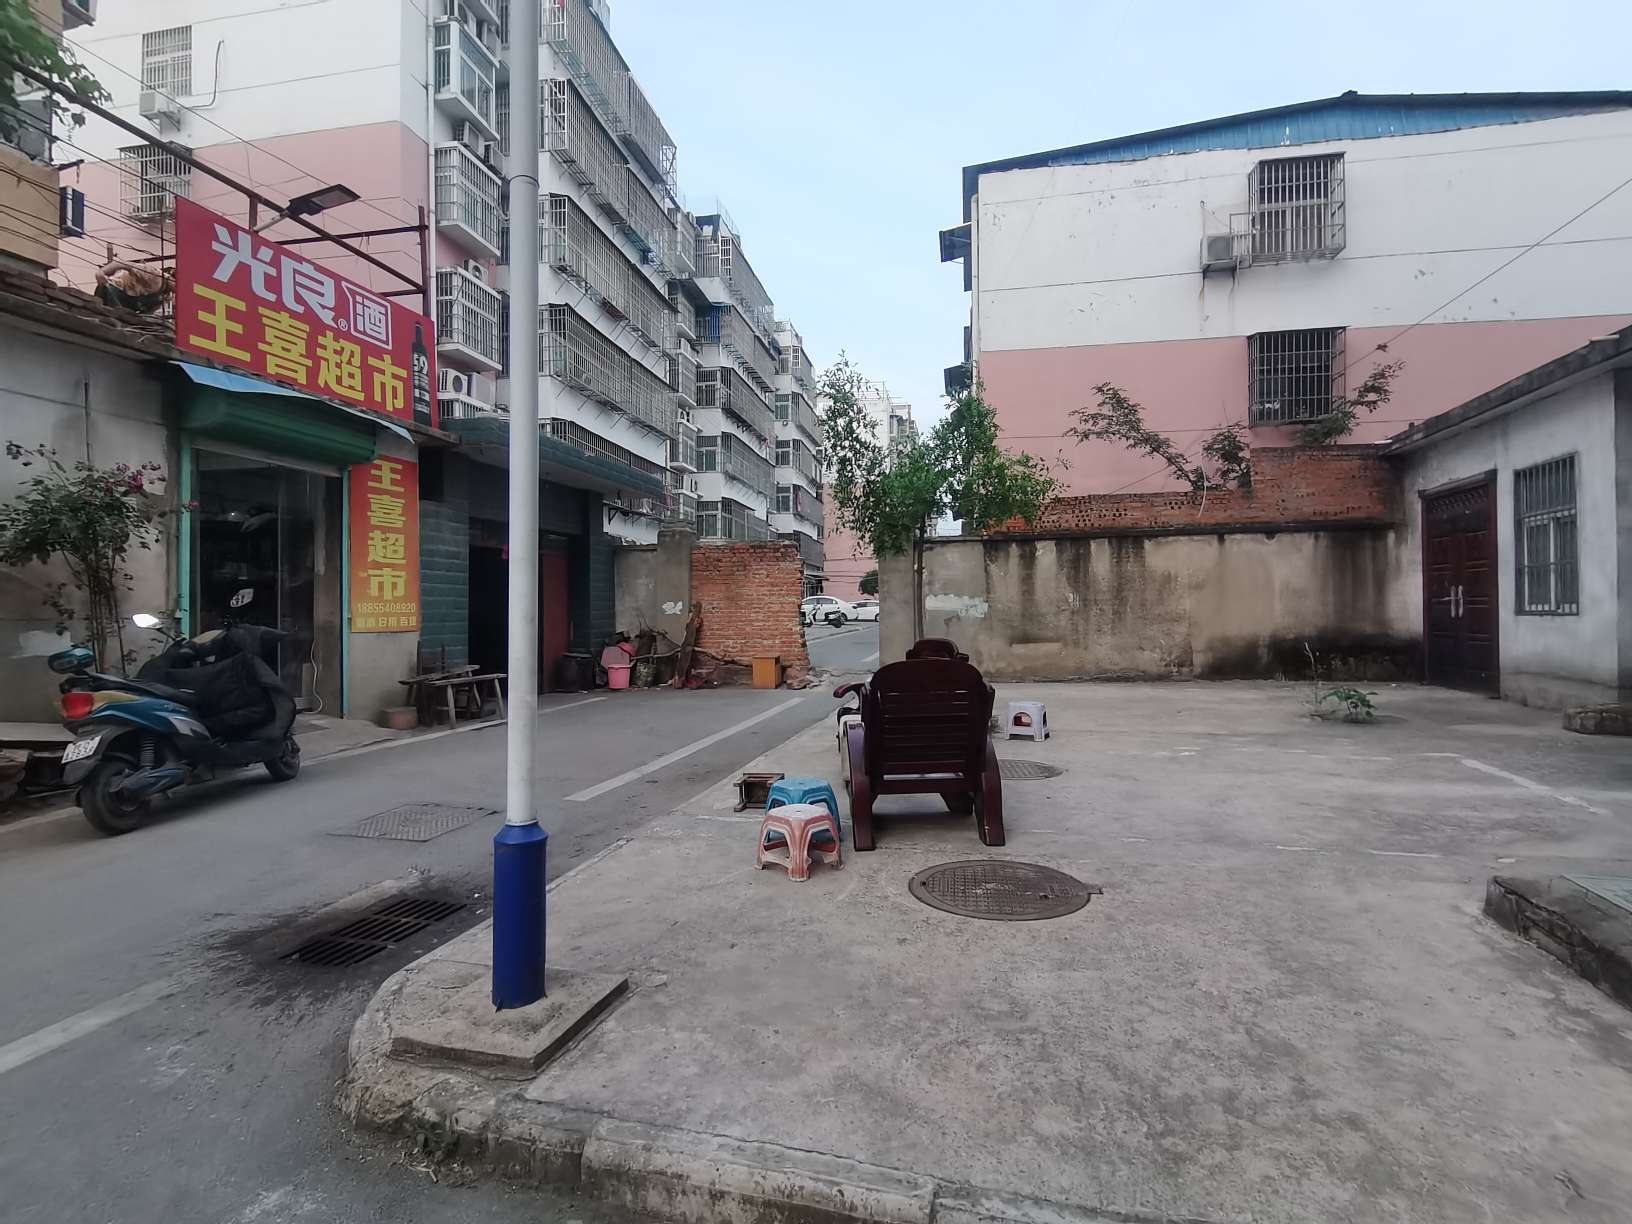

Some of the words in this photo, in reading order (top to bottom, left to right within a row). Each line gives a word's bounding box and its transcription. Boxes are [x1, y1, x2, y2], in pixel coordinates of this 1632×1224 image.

[189, 283, 408, 411] 王喜超市
[367, 458, 407, 600] 王喜超市
